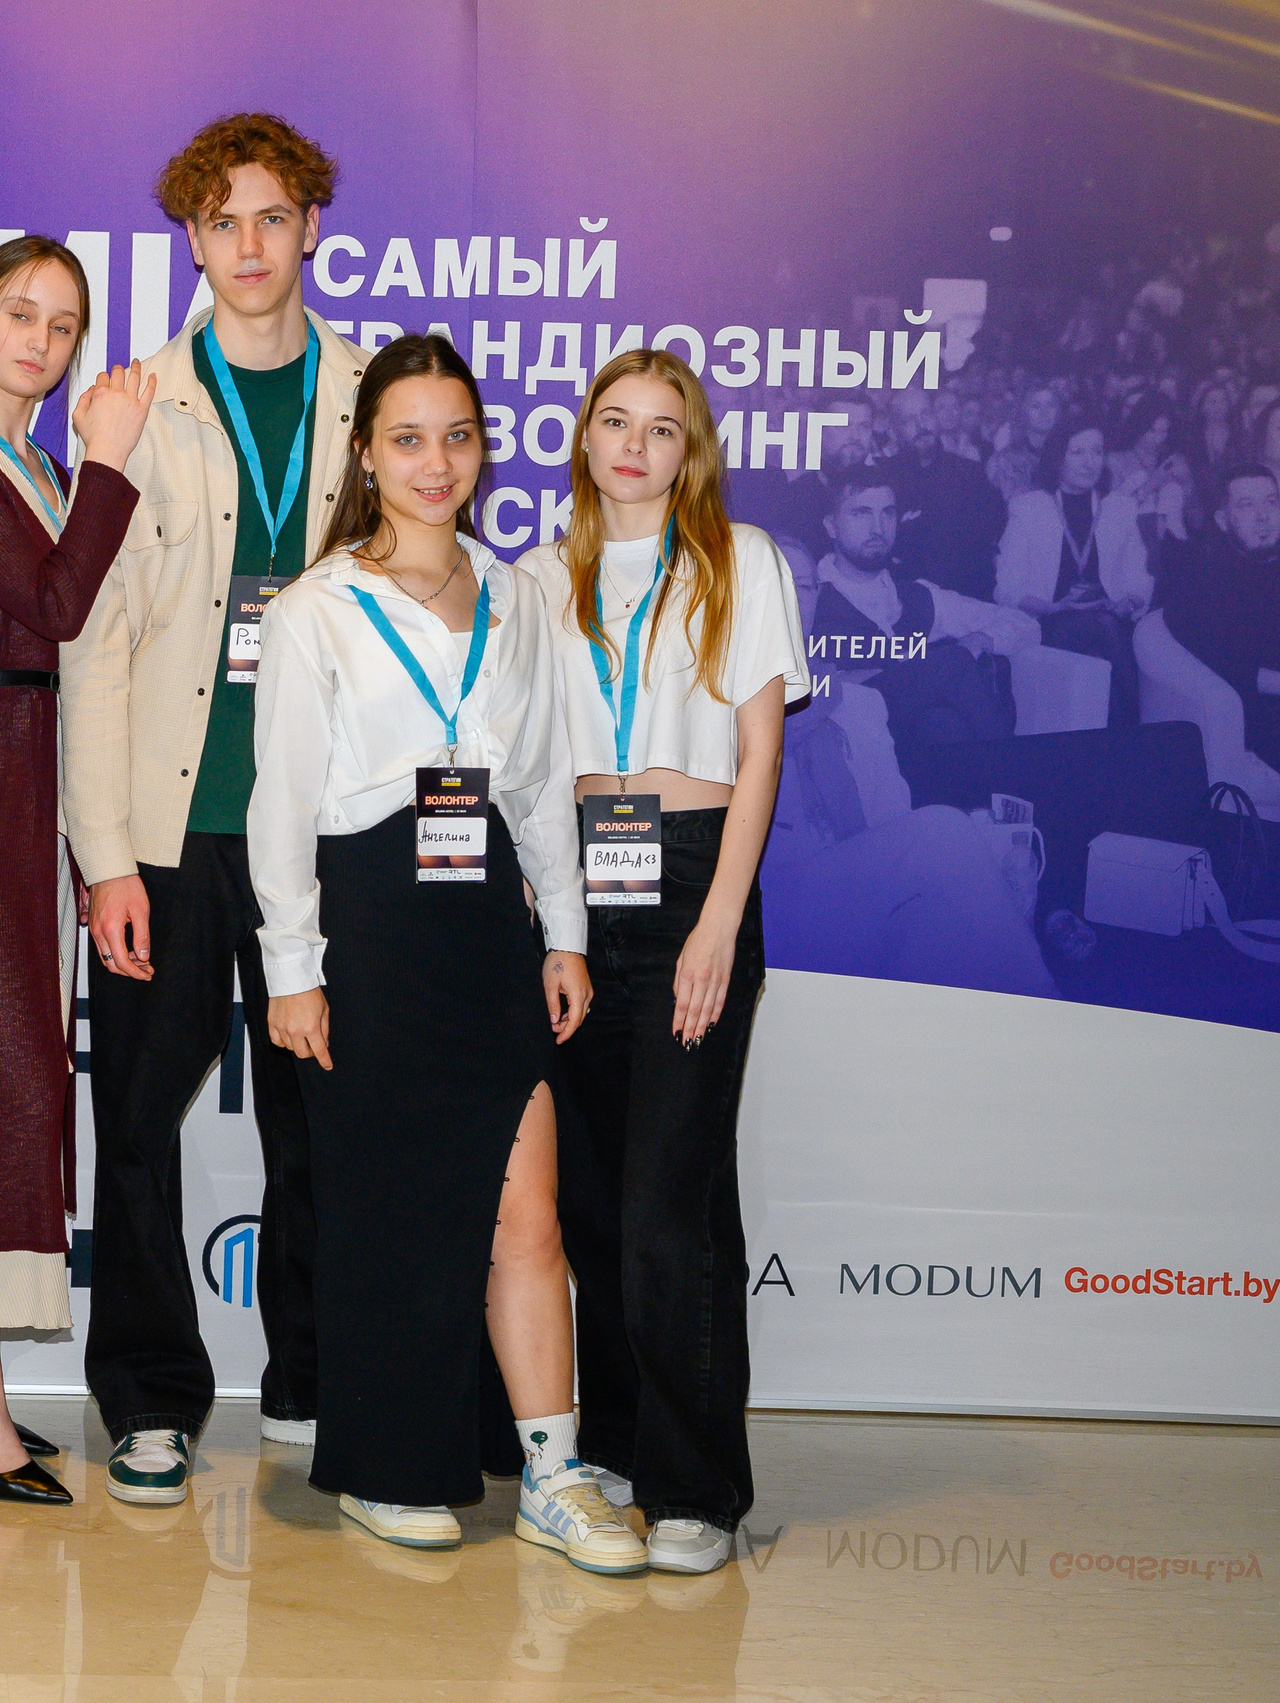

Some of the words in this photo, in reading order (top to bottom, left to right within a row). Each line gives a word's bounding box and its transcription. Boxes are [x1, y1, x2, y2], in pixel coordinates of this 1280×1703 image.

[312, 217, 617, 299] САМЫЙ
[425, 795, 479, 805] ВОЛОНТЕР
[595, 822, 652, 832] ВОЛОНТЕР
[839, 1263, 1042, 1299] MODUM
[1064, 1266, 1280, 1304] GoodStart.by
